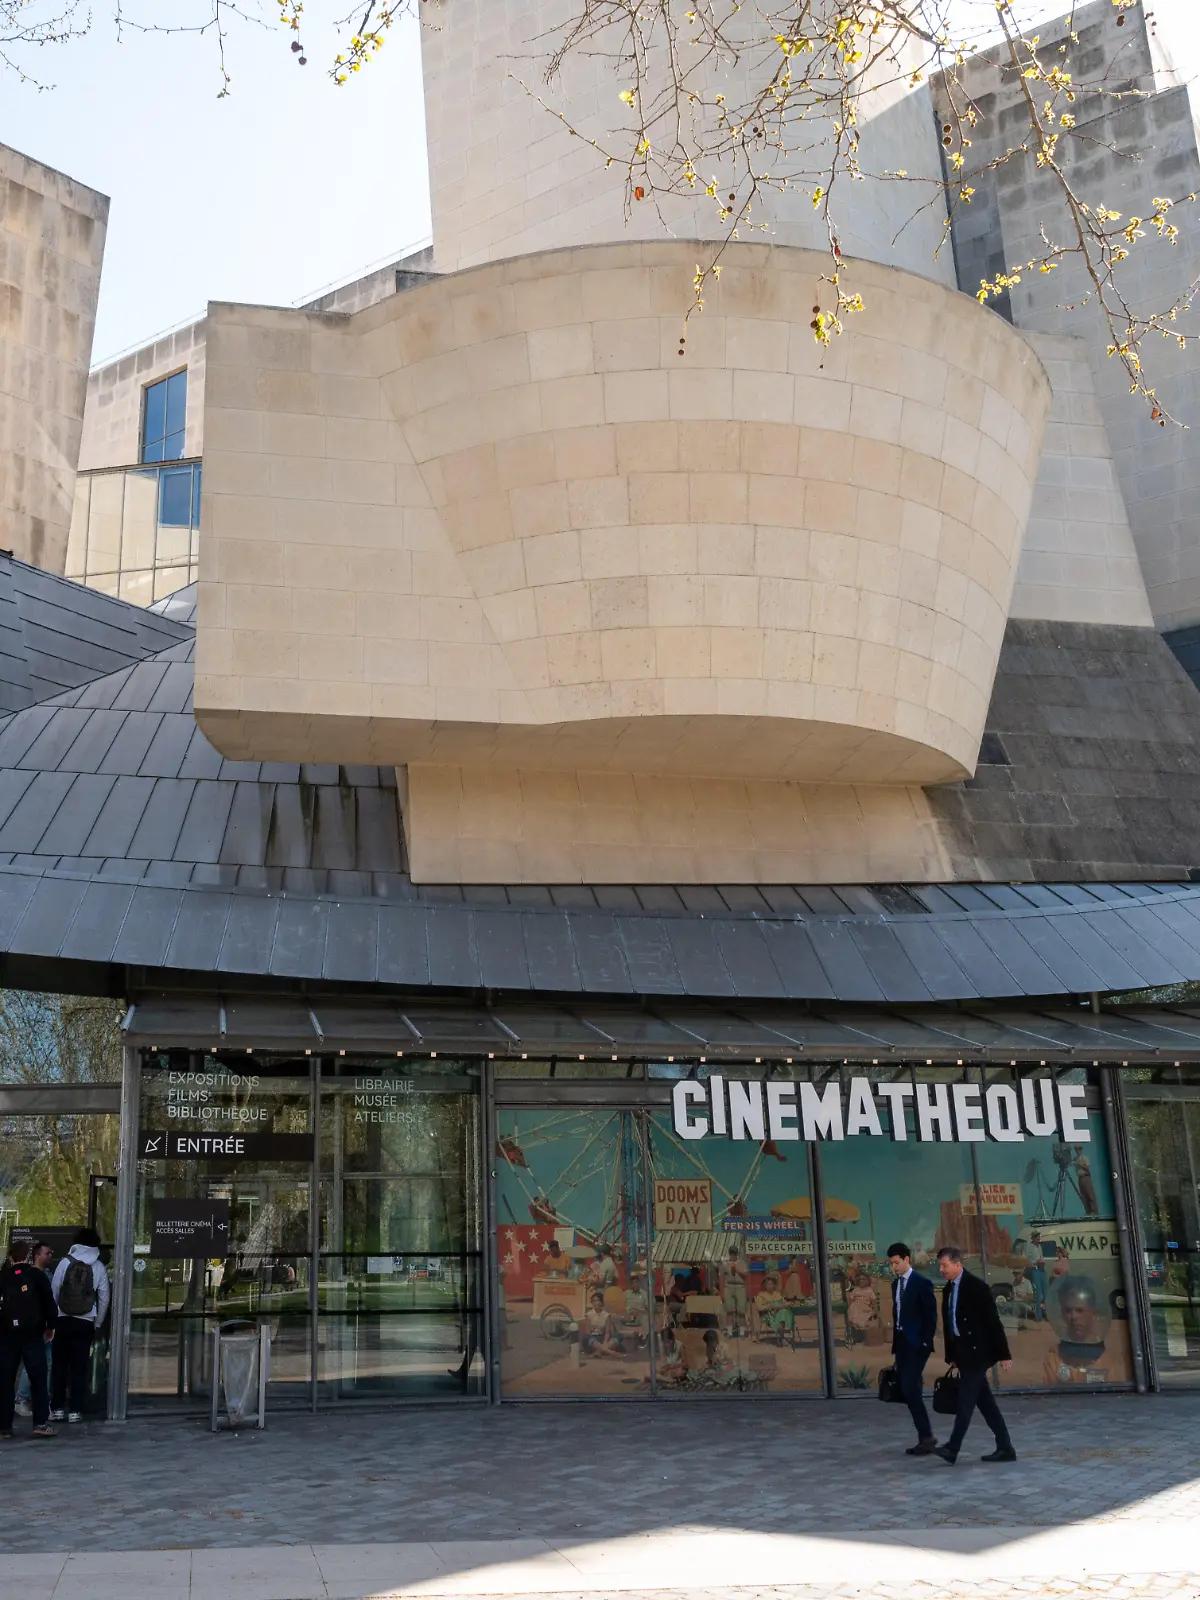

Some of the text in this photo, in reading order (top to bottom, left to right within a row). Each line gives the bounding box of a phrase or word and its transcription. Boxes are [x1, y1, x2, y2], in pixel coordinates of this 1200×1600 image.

[168, 1072, 260, 1087] EXPOSITIONS
[354, 1078, 416, 1092] LIBRAIRIE
[168, 1089, 208, 1102] FILMS
[354, 1093, 397, 1107] MUSÉE
[167, 1106, 268, 1122] BIBLIOTHÈQUE
[672, 1075, 1092, 1143] CINEMATHEQUE
[354, 1111, 414, 1124] ATELIERS
[176, 1136, 246, 1154] ENTRÉE
[657, 1185, 709, 1204] DOOMS
[666, 1207, 701, 1225] DAY
[724, 1221, 800, 1231] FERRIS WHEEL
[748, 1242, 874, 1252] SPACECRAFT SIGHTING
[1059, 1236, 1109, 1251] WKAP
